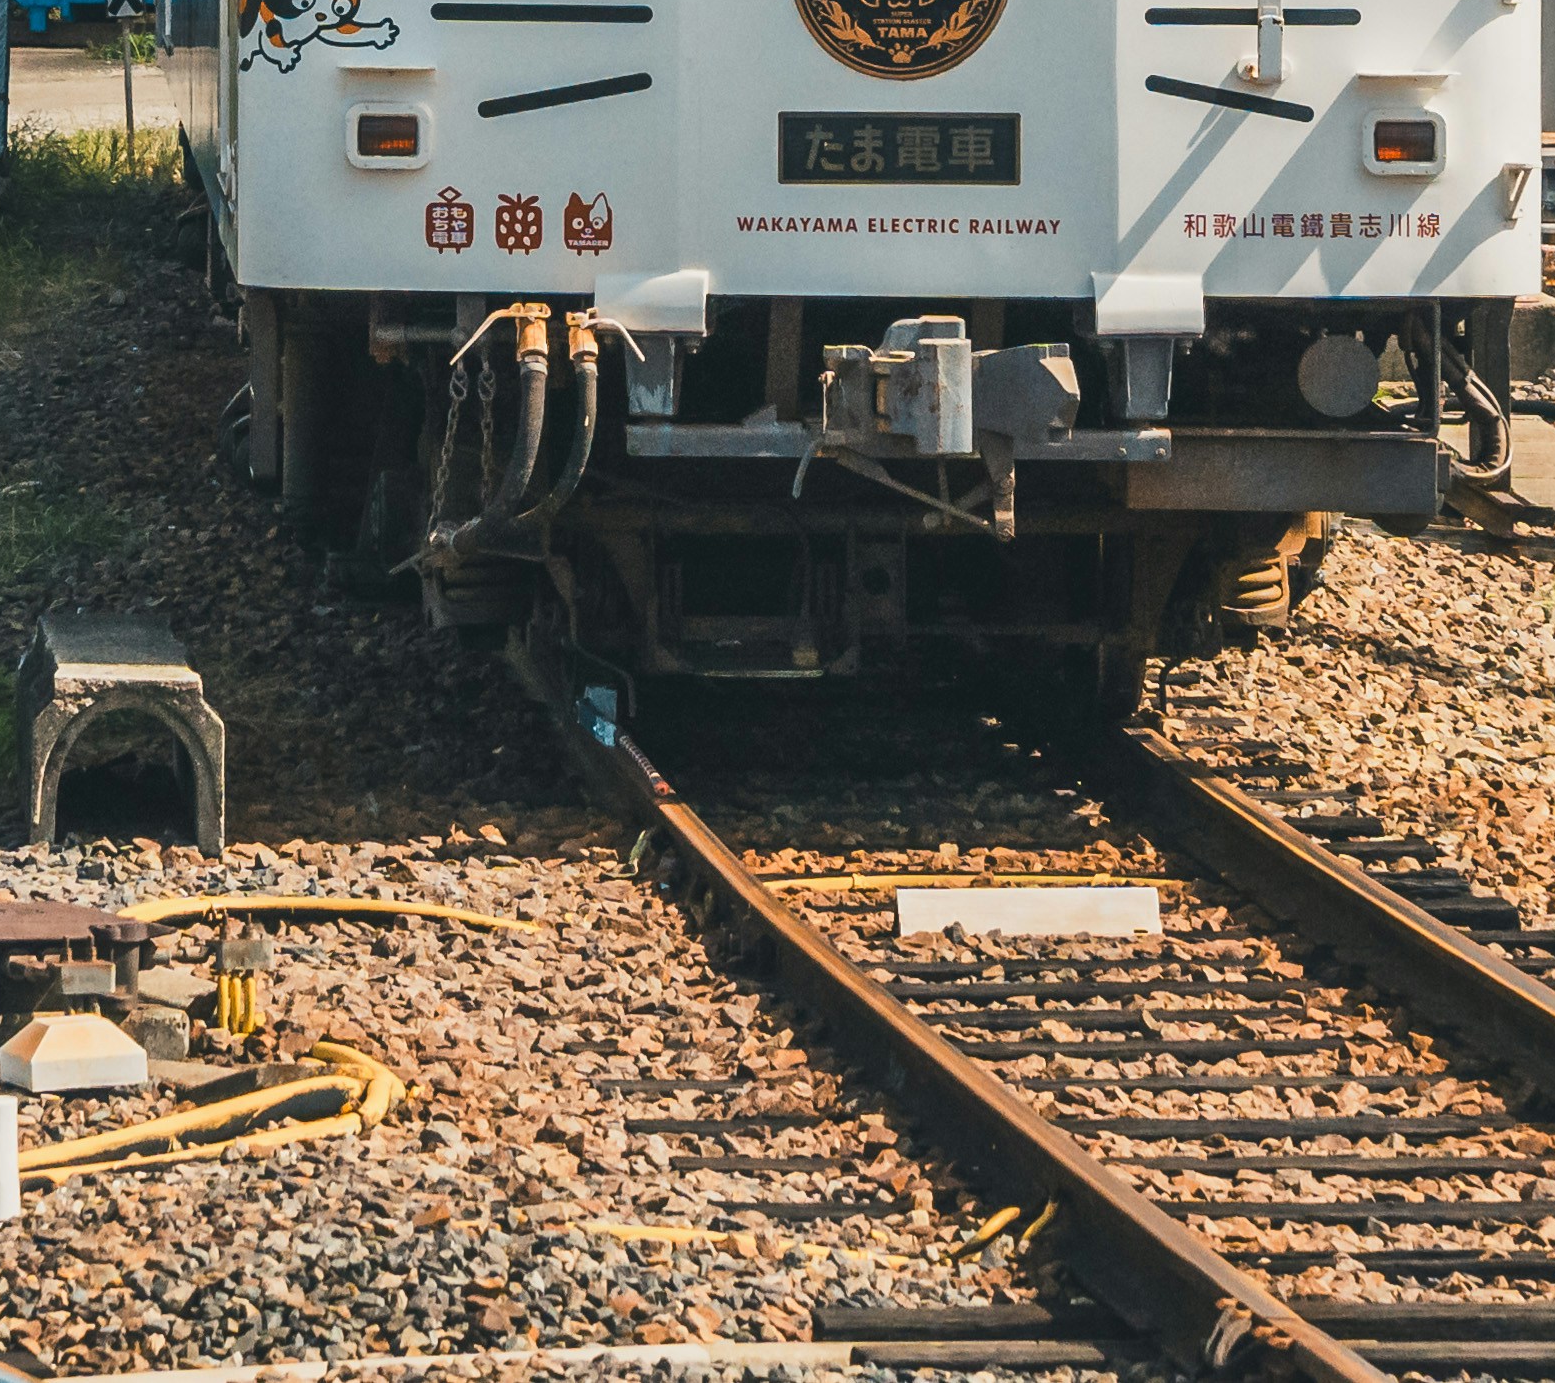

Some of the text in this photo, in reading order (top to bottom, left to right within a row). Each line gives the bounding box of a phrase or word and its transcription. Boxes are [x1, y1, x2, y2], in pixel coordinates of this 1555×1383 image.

[877, 27, 928, 38] TAMA
[805, 123, 995, 174] たま電車
[737, 216, 1061, 235] WAKAYAMA ELECTRIC RAILWAY
[1183, 212, 1441, 239] 和歌山電鐵貴志川線
